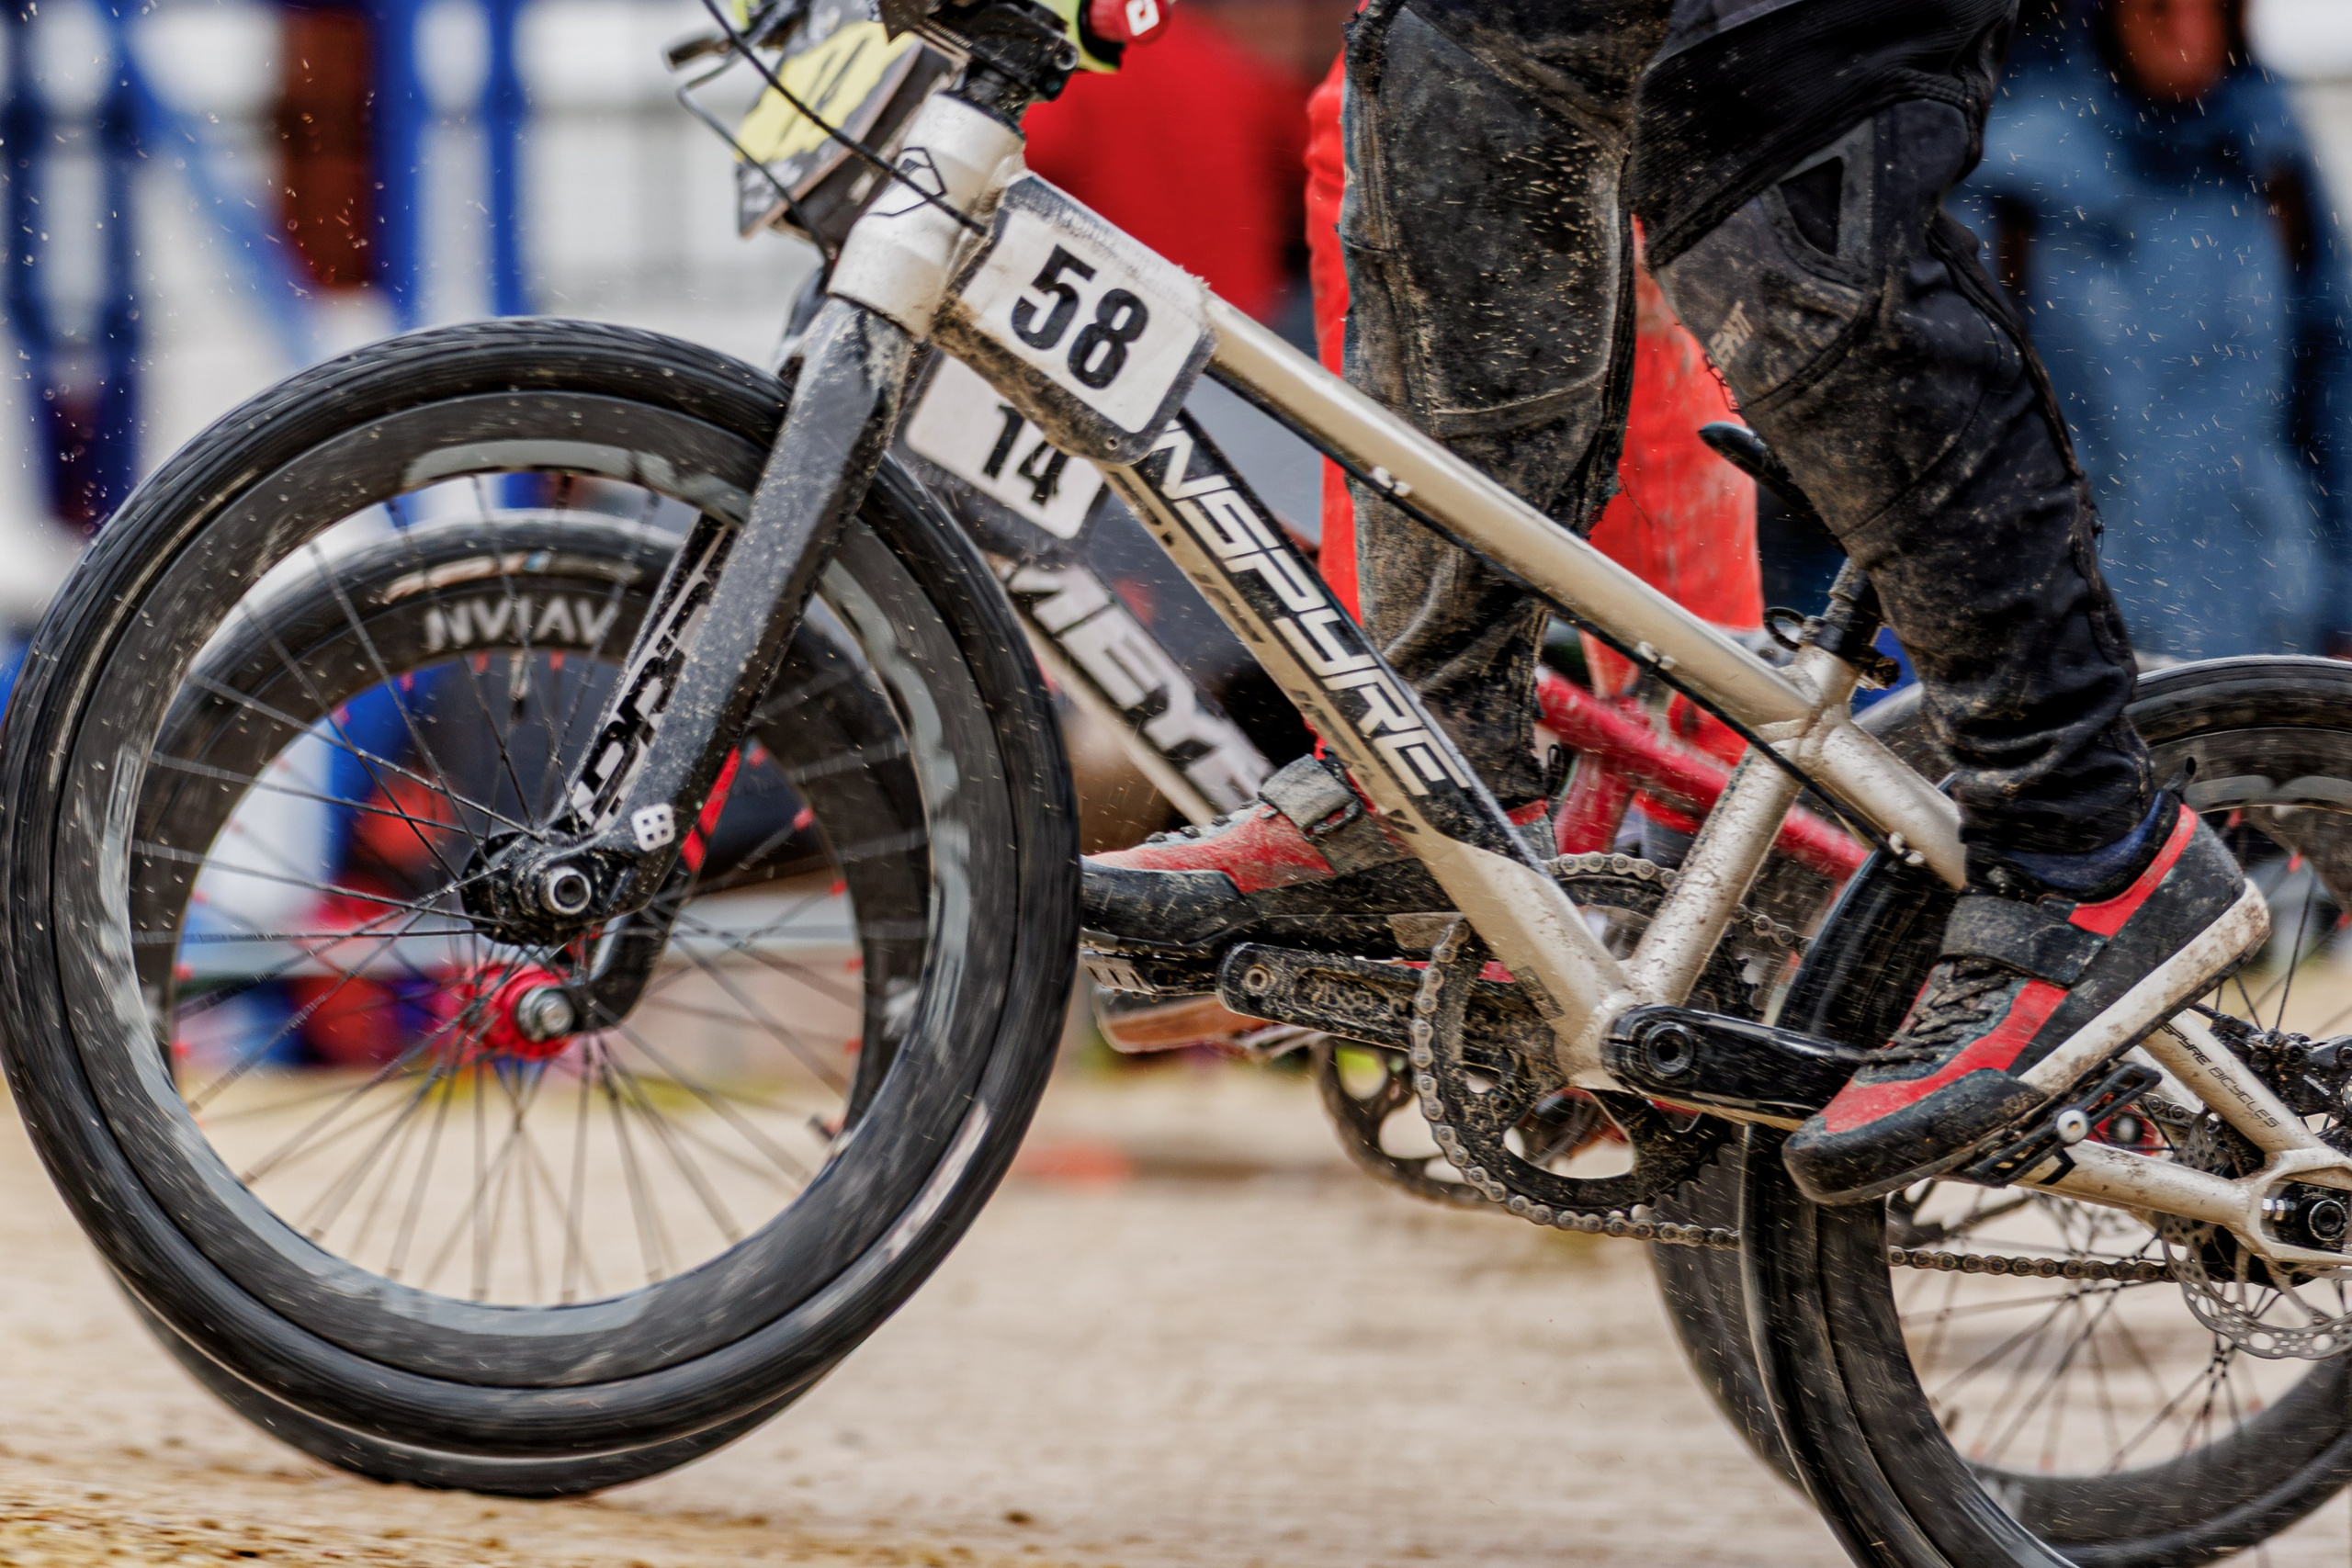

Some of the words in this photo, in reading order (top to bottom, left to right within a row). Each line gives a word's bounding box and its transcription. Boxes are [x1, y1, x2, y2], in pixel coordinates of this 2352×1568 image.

[1011, 243, 1149, 390] 58
[982, 404, 1069, 507] 14
[1148, 419, 1471, 795] NSPYRE
[2208, 1066, 2281, 1129] BICYCLES
